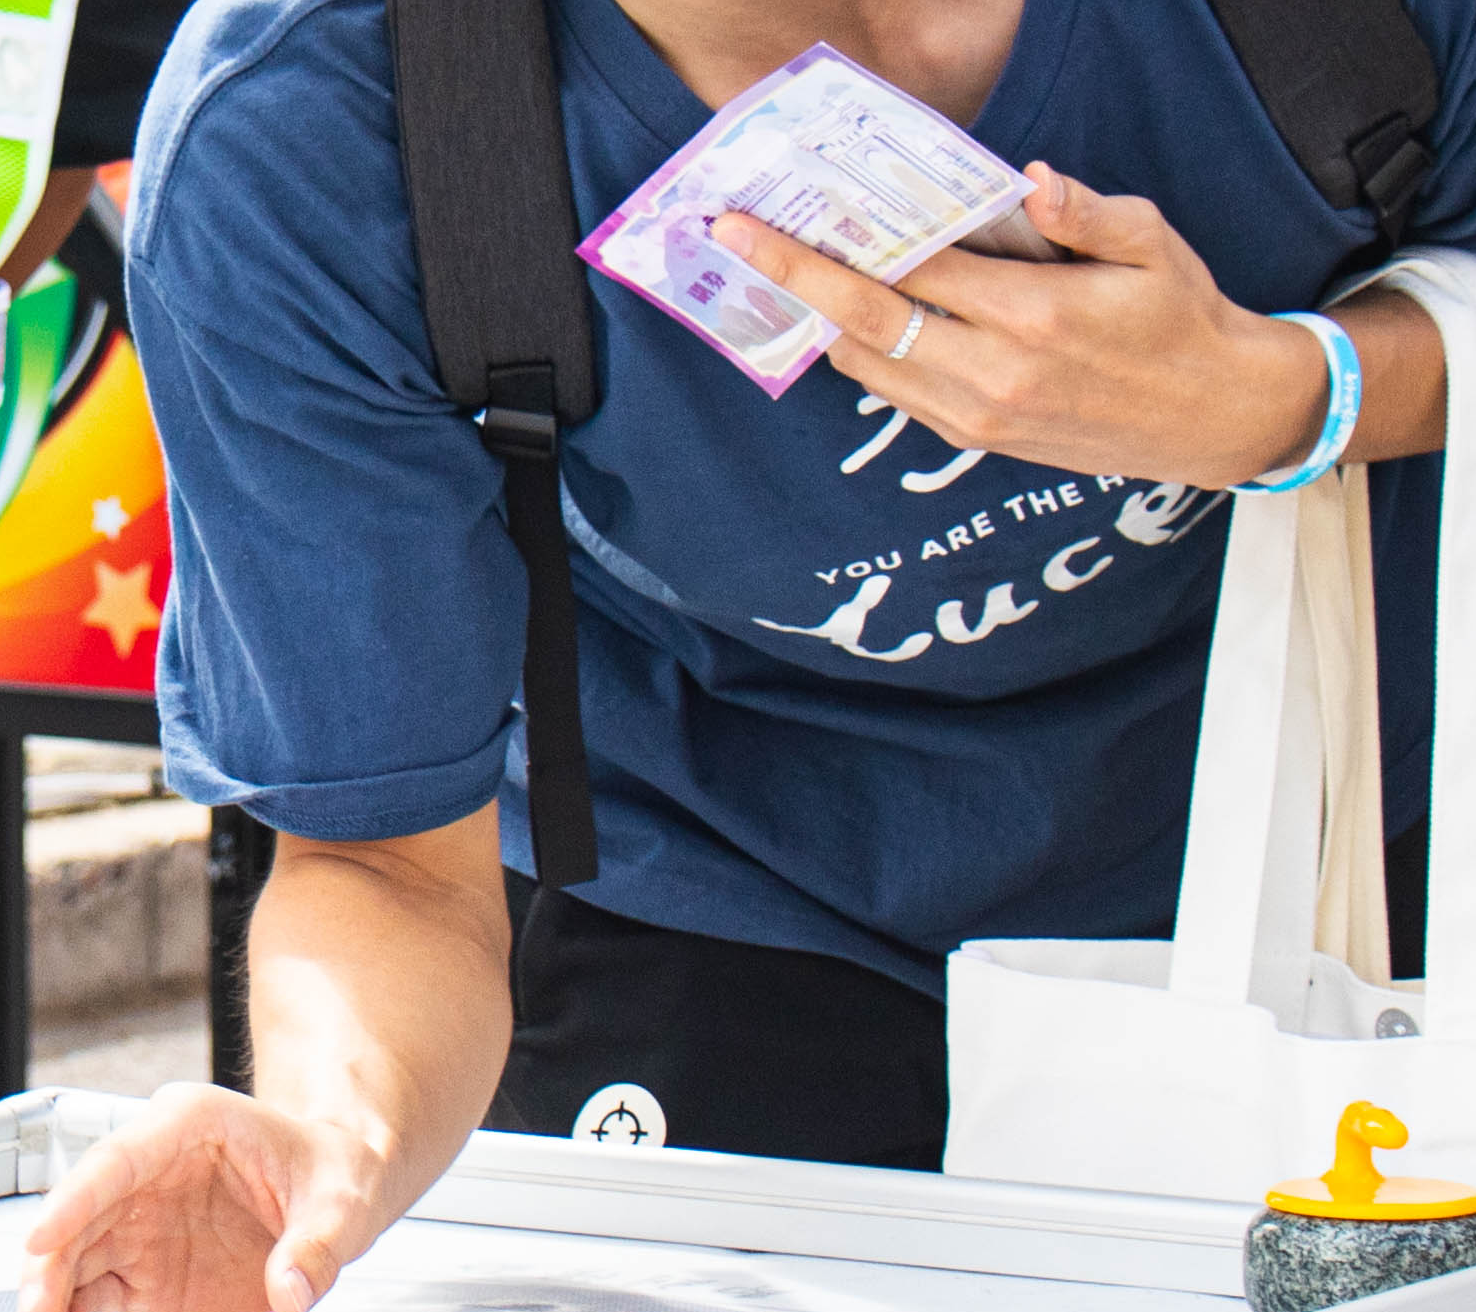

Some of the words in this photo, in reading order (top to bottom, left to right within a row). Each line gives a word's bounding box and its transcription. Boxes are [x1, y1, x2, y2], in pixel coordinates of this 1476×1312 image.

[814, 550, 904, 587] YOU
[920, 510, 996, 561] ARE
[1003, 480, 1085, 525] THE
